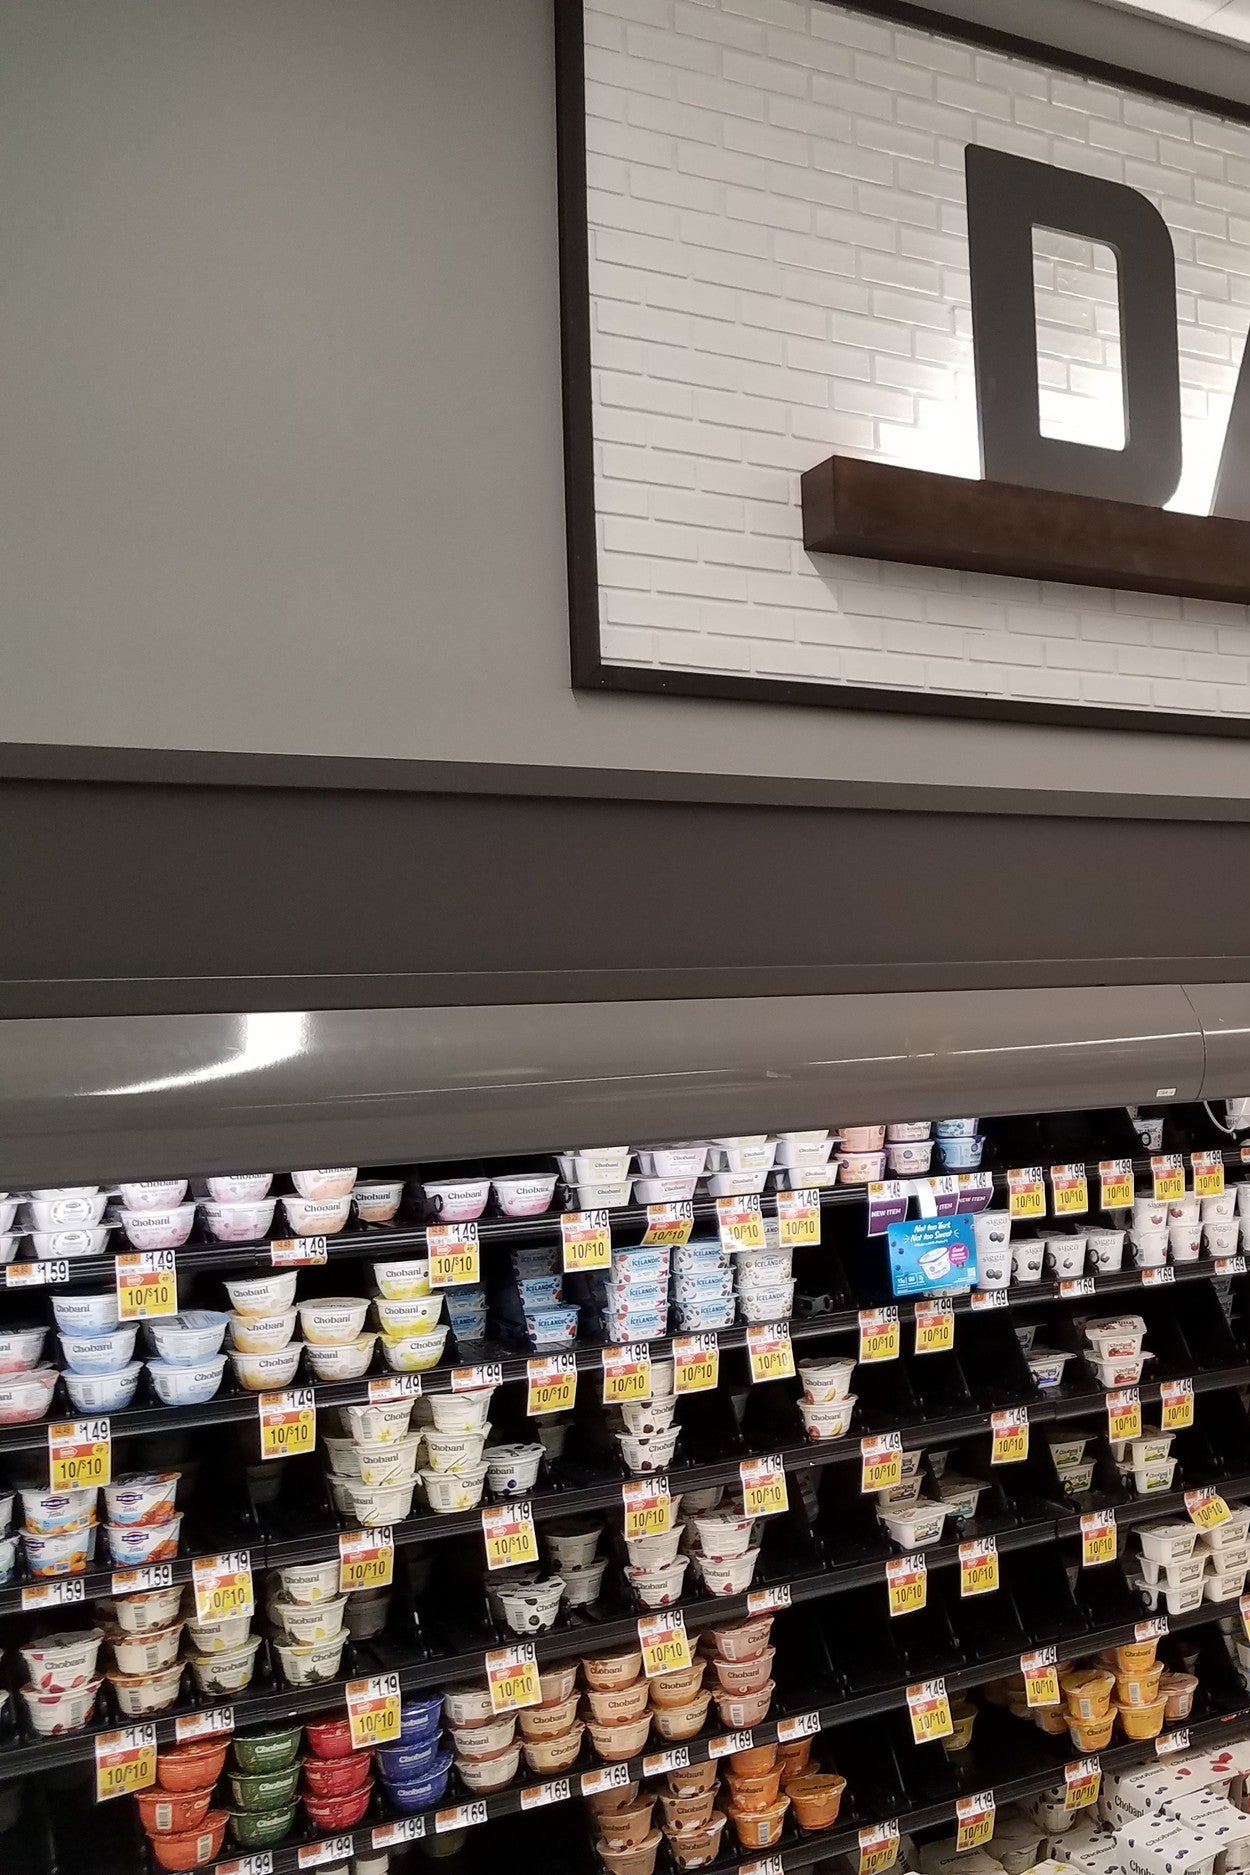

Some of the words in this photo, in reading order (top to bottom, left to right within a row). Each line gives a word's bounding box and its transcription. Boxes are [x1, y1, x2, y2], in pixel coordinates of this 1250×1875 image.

[1160, 1180, 1181, 1192] 10/$10
[1199, 1178, 1220, 1190] 10/$10
[356, 1191, 390, 1200] Chobani
[448, 1190, 482, 1200] Chobani
[1060, 1190, 1084, 1204] 10/$10
[1107, 1186, 1130, 1200] 10/$10
[304, 1202, 341, 1212] Chobani
[1016, 1194, 1040, 1208] 10/$10
[132, 1216, 170, 1226] Chobani
[786, 1220, 815, 1236] 10/$10
[652, 1230, 684, 1241] 10/$10
[571, 1242, 604, 1259] 10/$10
[438, 1256, 472, 1274] 10/$10
[386, 1268, 421, 1278] Chobani
[128, 1286, 168, 1306] 10/$10
[234, 1287, 268, 1297] Chobani
[57, 1304, 90, 1313] Chobani
[384, 1306, 418, 1315] Chobani
[314, 1316, 350, 1324] Chobani
[922, 1328, 948, 1342] 10/$10
[73, 1342, 112, 1352] Chobani
[410, 1339, 442, 1350] Chobani
[868, 1336, 894, 1352] 10/$10
[259, 1356, 294, 1368] Chobani
[758, 1353, 788, 1370] 10/$10
[682, 1364, 712, 1382] 10/$10
[612, 1376, 645, 1392] 10/$10
[805, 1379, 834, 1387] Chobani
[536, 1386, 569, 1402] 10/$10
[811, 1413, 841, 1422] Chobani
[1168, 1406, 1190, 1420] 10/$10
[1114, 1416, 1136, 1431] 10/$10
[271, 1424, 308, 1444] 10/$10
[431, 1443, 464, 1452] Chobani
[999, 1438, 1024, 1452] 10/$10
[362, 1454, 399, 1464] Chobani
[60, 1458, 102, 1479] 10/$10
[869, 1464, 896, 1481] 10/$10
[751, 1487, 780, 1505] 10/$10
[632, 1508, 664, 1528] 10/$10
[1198, 1502, 1222, 1522] 10/$10
[494, 1536, 529, 1554] 10/$10
[1088, 1540, 1112, 1554] 10/$10
[350, 1560, 386, 1580] 10/$10
[968, 1567, 993, 1584] 10/$10
[285, 1574, 320, 1585] Chobani
[636, 1582, 667, 1591] Chobani
[896, 1585, 921, 1604] 10/$10
[286, 1613, 323, 1625] Chobani
[650, 1642, 682, 1662] 10/$10
[45, 1656, 86, 1670] Chobani
[211, 1659, 248, 1674] Chobani
[590, 1666, 622, 1675] Chobani
[728, 1669, 759, 1679] Chobani
[498, 1677, 533, 1699] 10/$10
[659, 1679, 693, 1690] Chobani
[1032, 1680, 1053, 1694] 10/$10
[608, 1696, 640, 1708] Chobani
[359, 1711, 393, 1732] 10/$10
[533, 1713, 567, 1724] Chobani
[918, 1711, 946, 1731] 10/$10
[107, 1762, 148, 1786] 10/$10
[1130, 1769, 1164, 1783] Chobani
[1114, 1796, 1144, 1818] Chobani
[964, 1824, 989, 1840] 10/$10
[1145, 1826, 1182, 1847] Chobani
[866, 1849, 892, 1868] 10/$10
